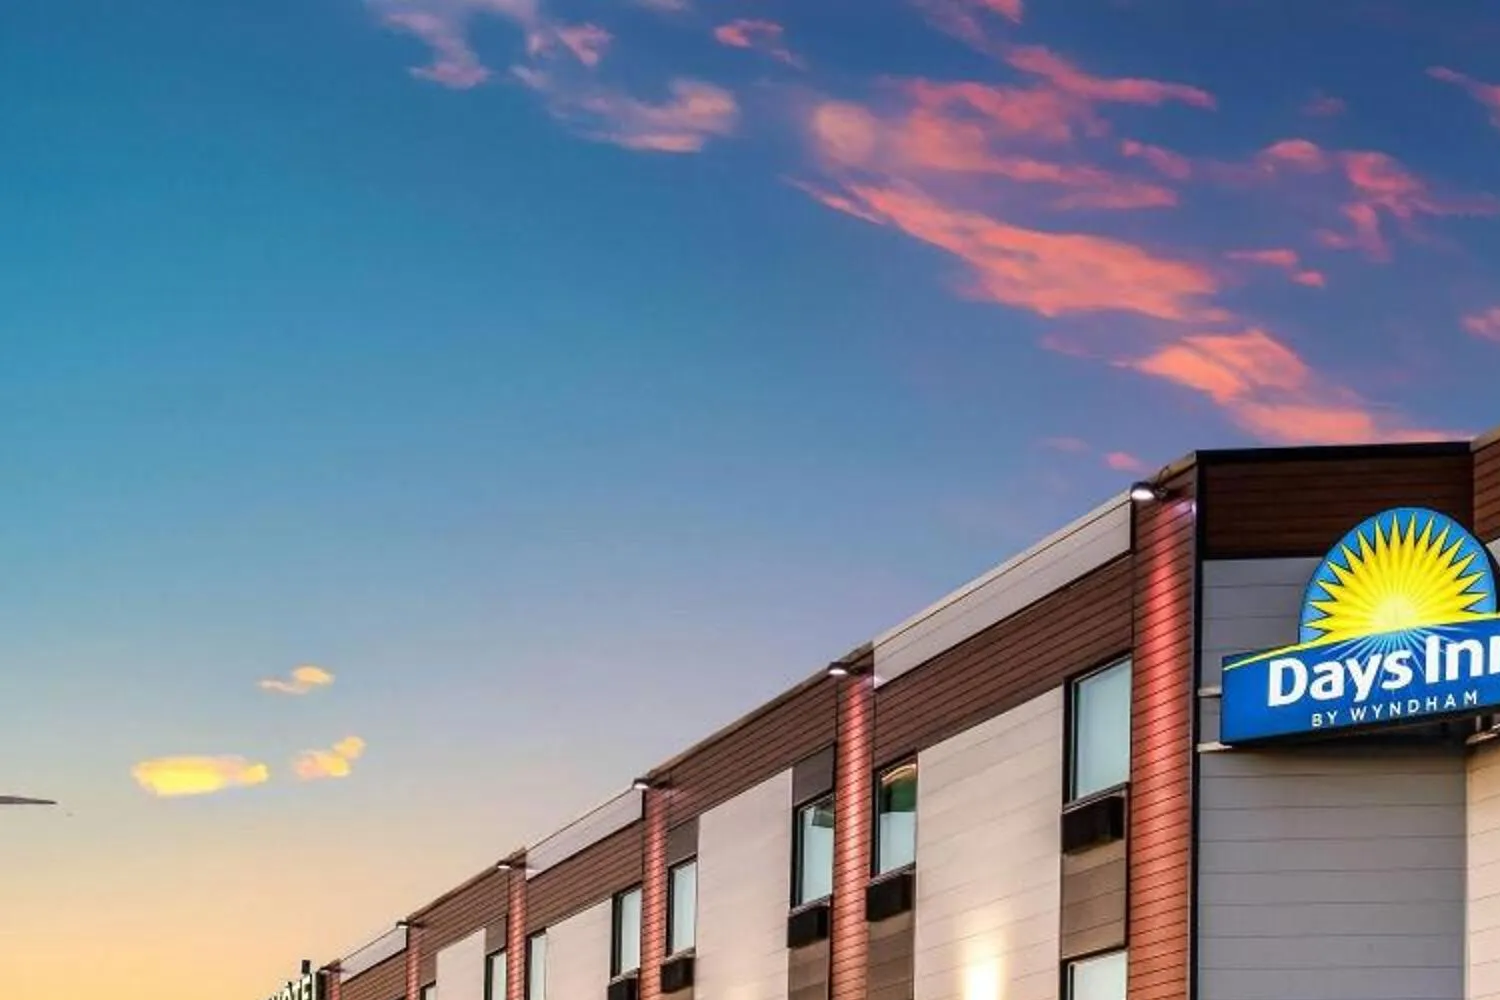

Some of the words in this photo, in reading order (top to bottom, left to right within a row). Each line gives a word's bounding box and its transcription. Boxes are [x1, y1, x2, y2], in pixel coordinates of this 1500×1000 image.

[1267, 649, 1413, 706] Days
[1311, 710, 1339, 728] BY
[1350, 690, 1478, 721] WYNDHAM
